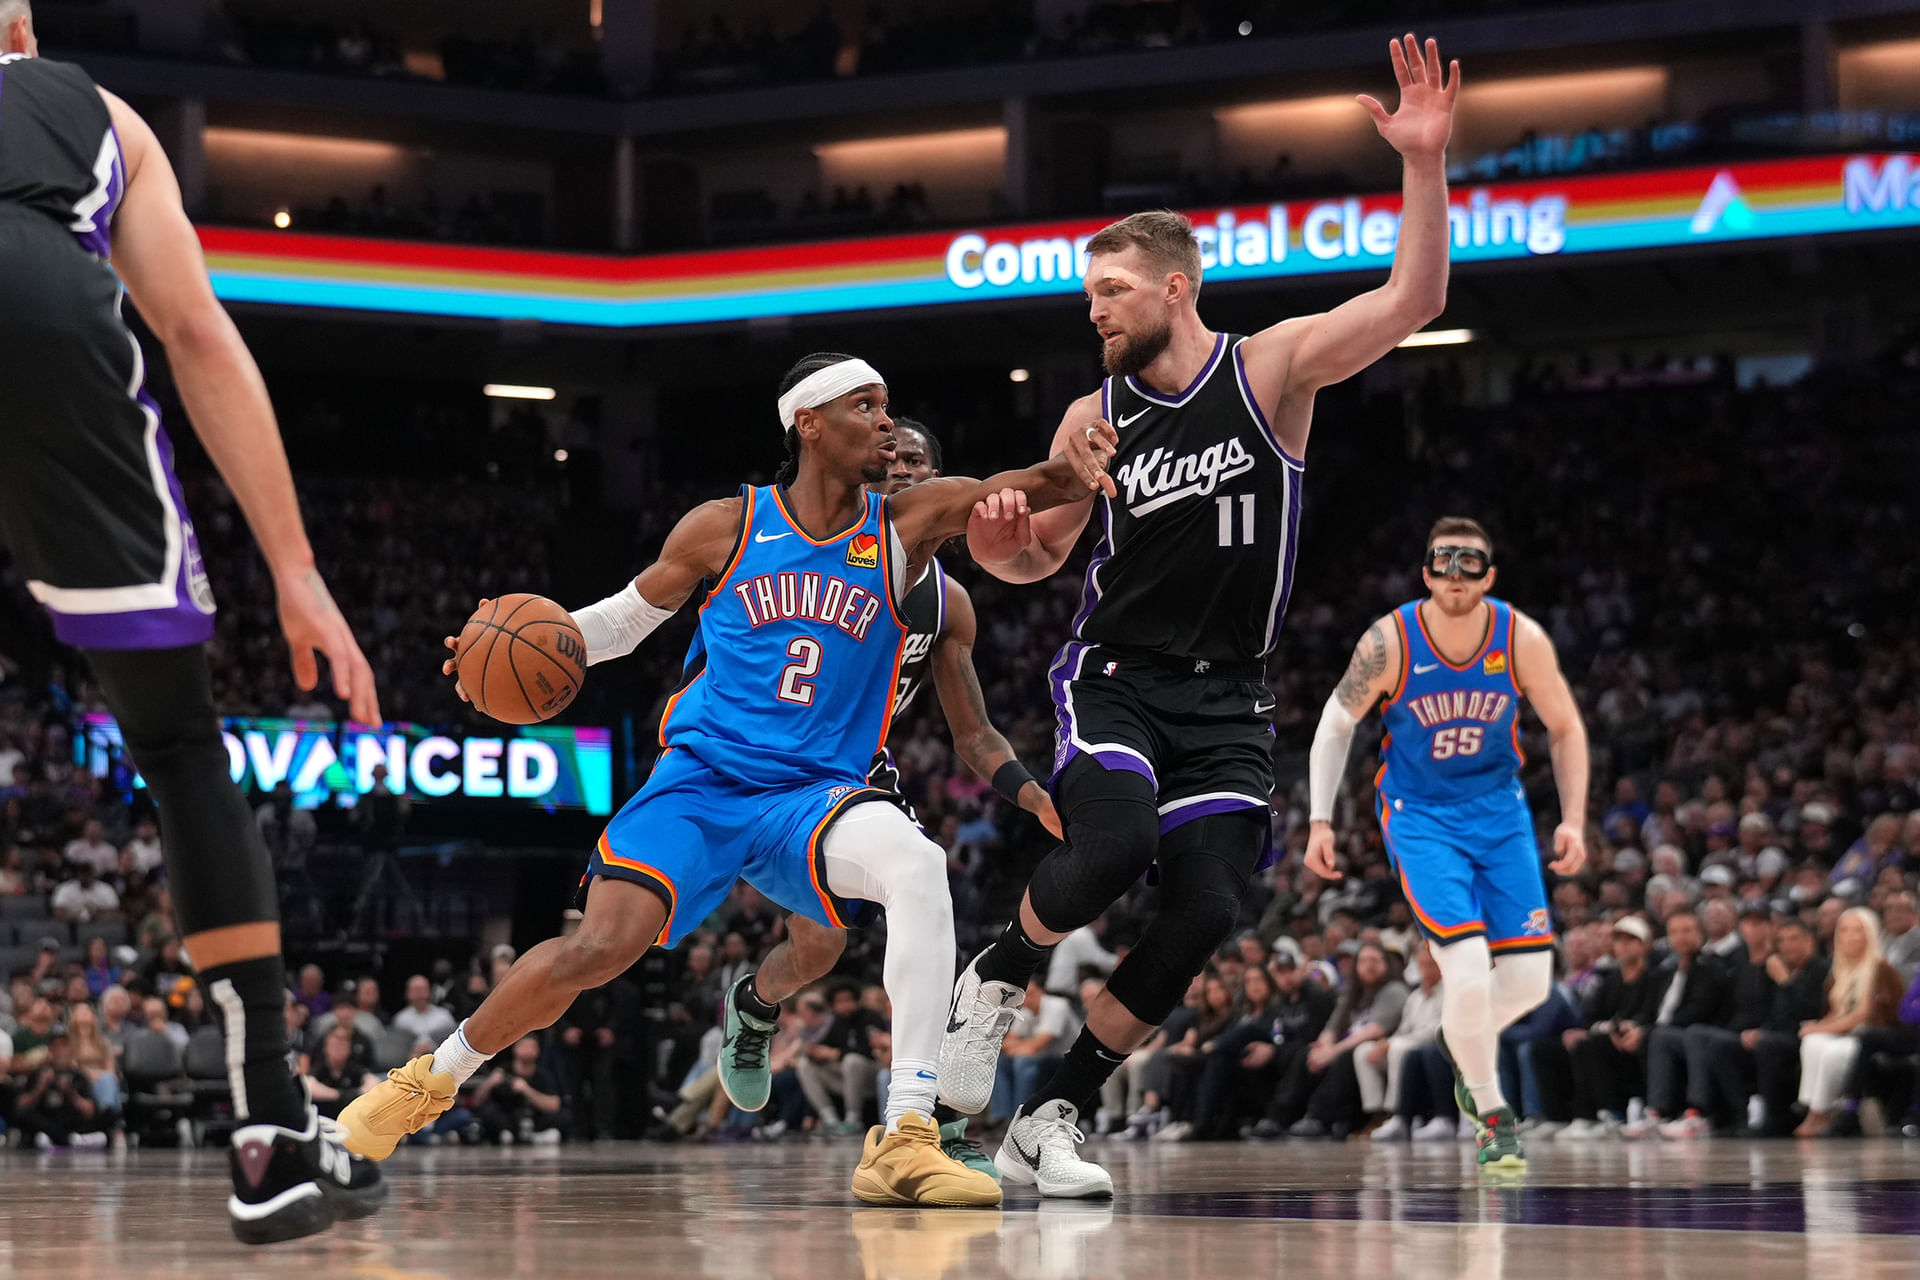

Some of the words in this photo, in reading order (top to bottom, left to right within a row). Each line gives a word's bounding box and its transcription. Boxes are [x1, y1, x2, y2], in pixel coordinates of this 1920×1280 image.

[946, 203, 1288, 288] Comcial
[1303, 190, 1567, 261] Clening
[1117, 437, 1255, 518] Kings
[1215, 494, 1255, 546] 11
[734, 571, 881, 643] THUNDER
[776, 636, 823, 706] 2
[1408, 690, 1510, 728] THUNDER
[1432, 726, 1484, 760] 55
[224, 731, 559, 798] VANCED
